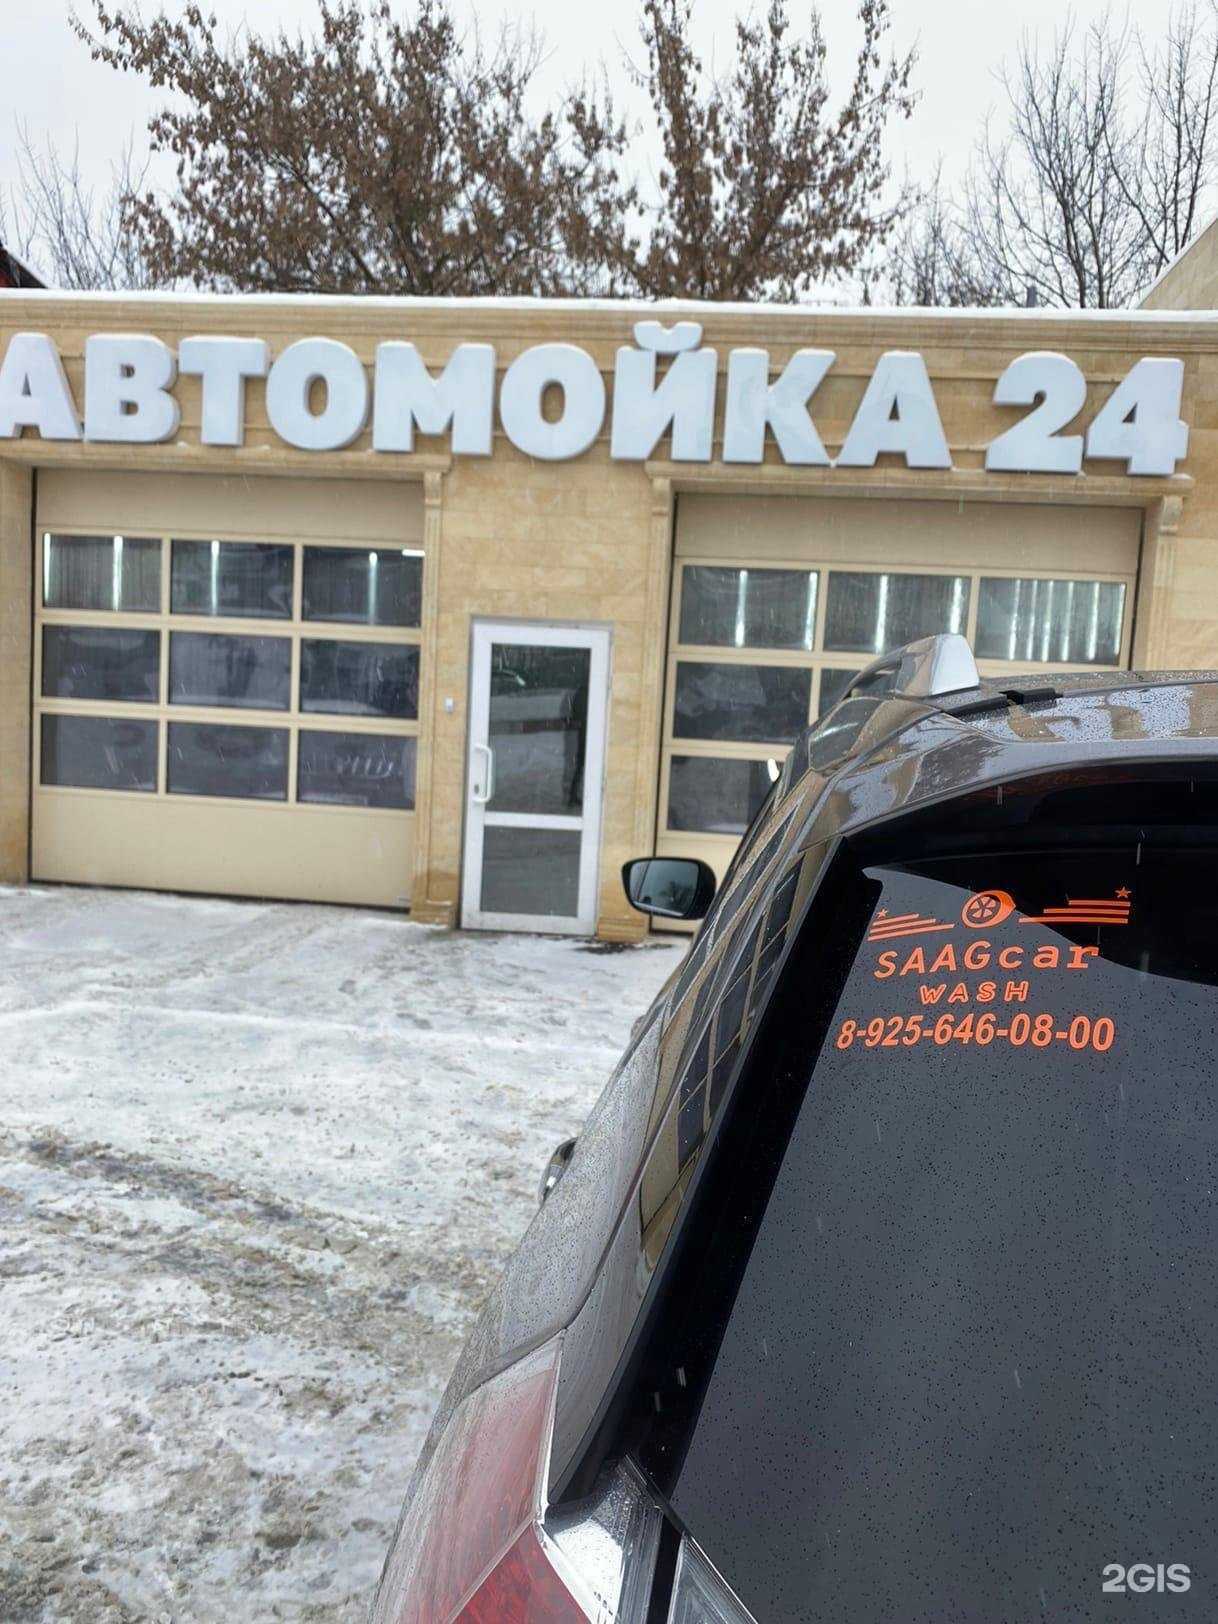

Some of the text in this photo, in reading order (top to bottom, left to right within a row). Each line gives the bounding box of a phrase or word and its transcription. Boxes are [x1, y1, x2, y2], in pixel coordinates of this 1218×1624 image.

[0, 320, 1189, 476] АВТОМОЙКА 24
[919, 980, 1030, 1005] WASH
[836, 1012, 1115, 1051] 8-925-646-08-00
